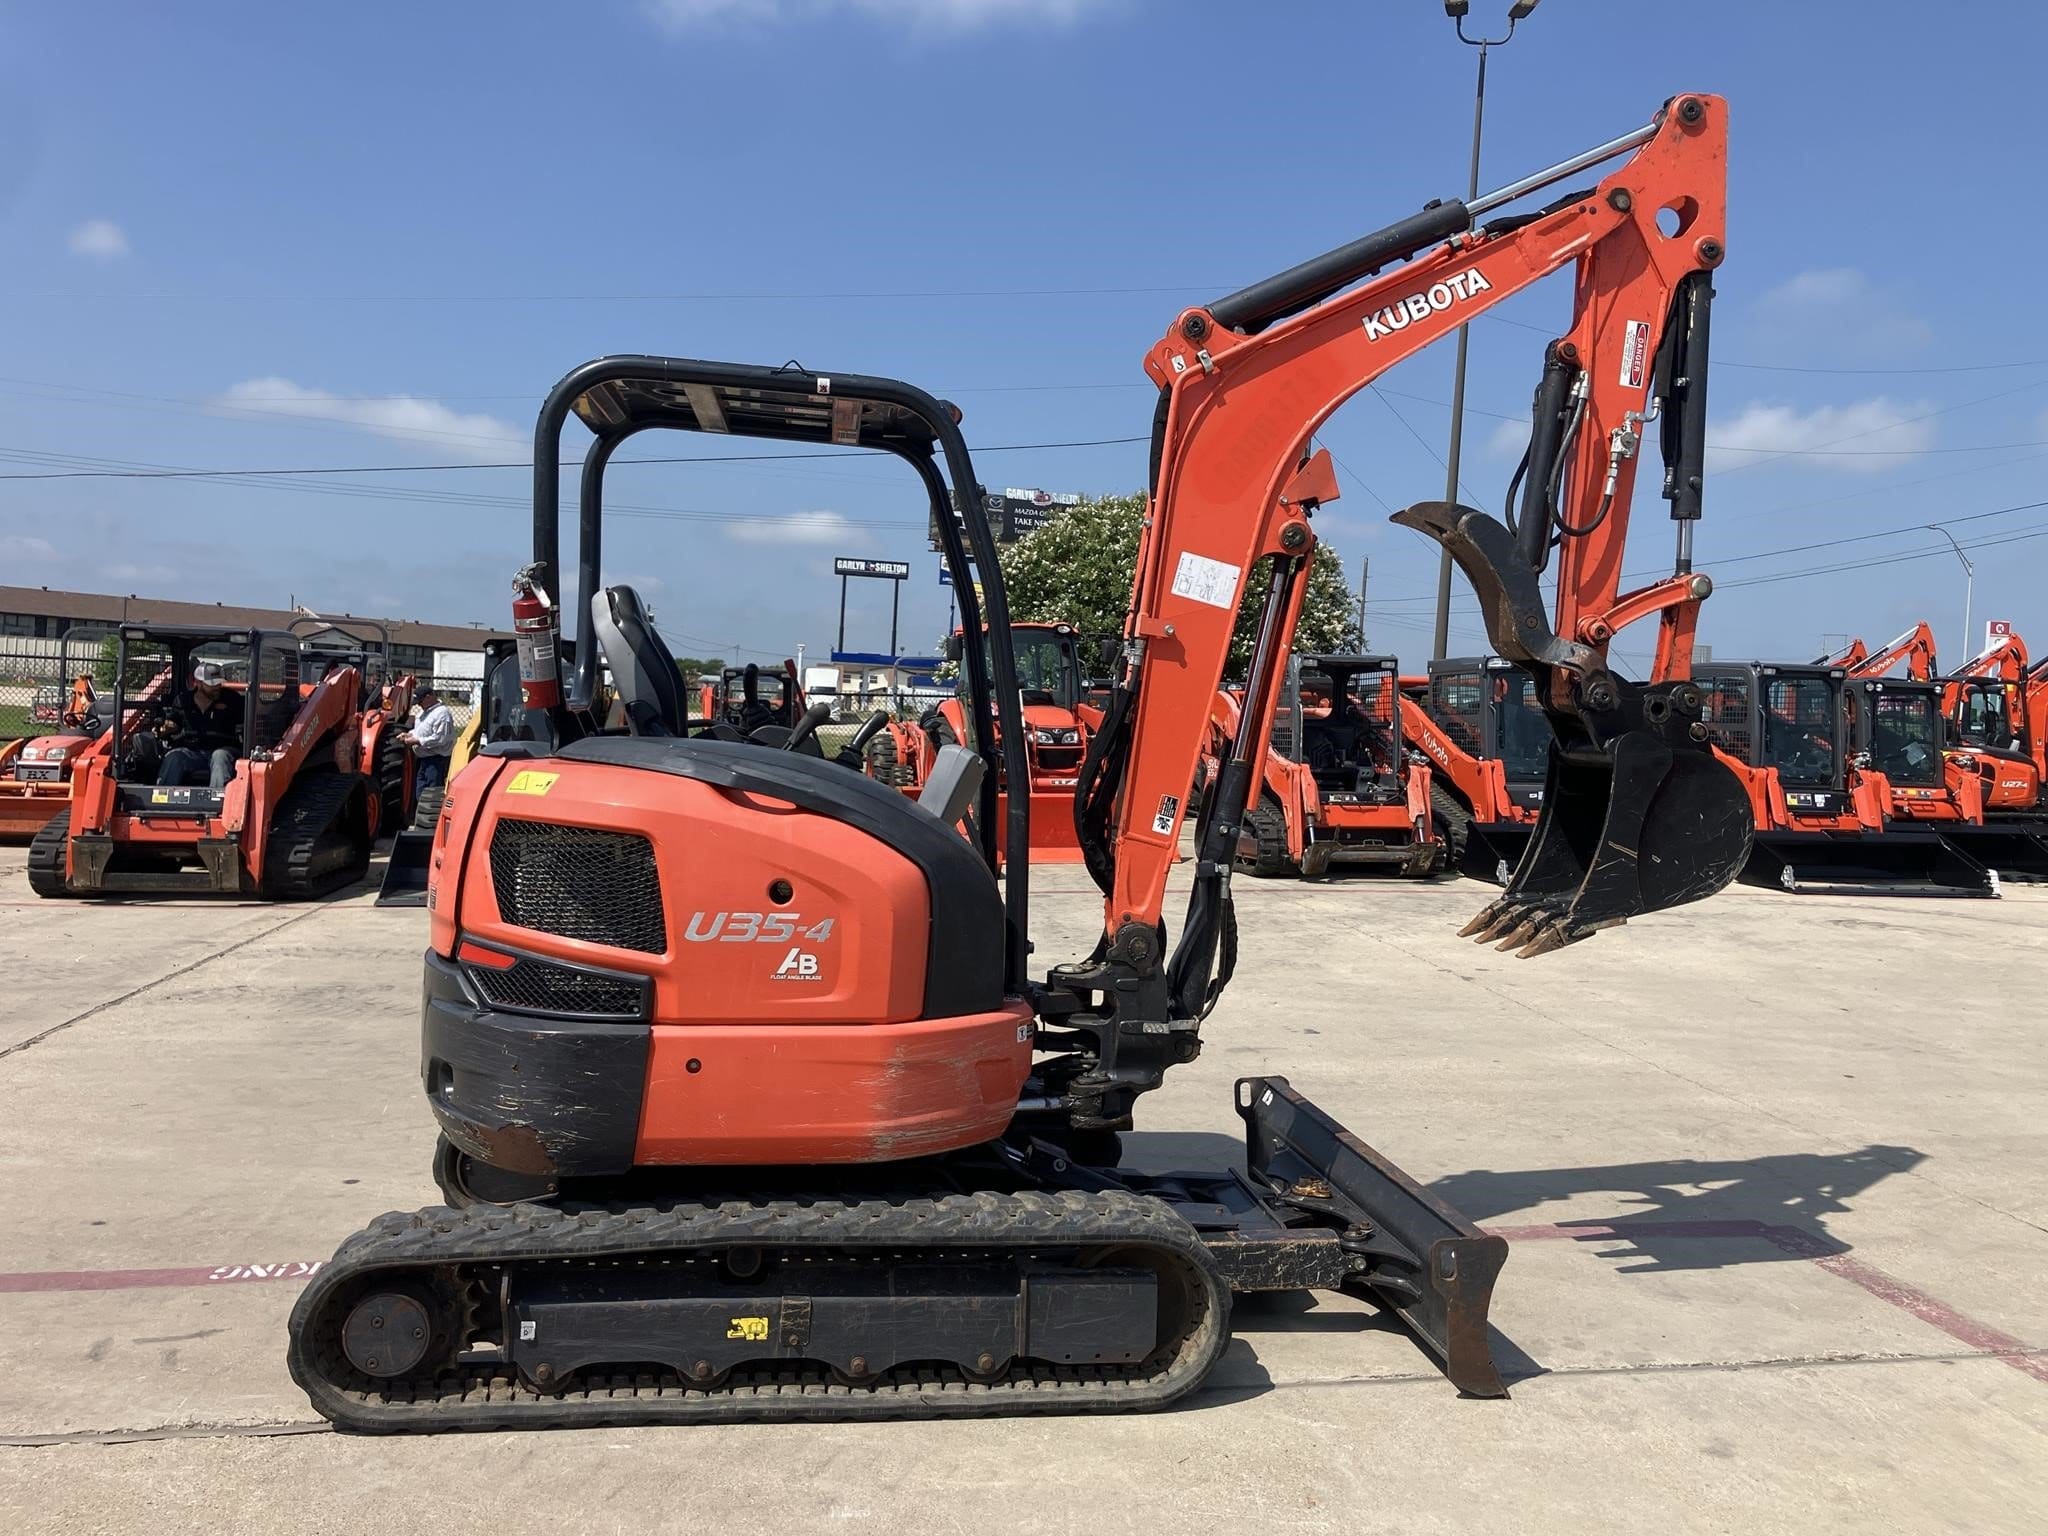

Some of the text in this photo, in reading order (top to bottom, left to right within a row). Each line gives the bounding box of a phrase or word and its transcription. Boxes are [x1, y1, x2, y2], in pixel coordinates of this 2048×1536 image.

[1361, 267, 1492, 342] KUBOTA
[1633, 337, 1644, 372] DANGER
[1014, 508, 1038, 516] MAZDA
[1014, 517, 1033, 526] TAKE
[837, 560, 907, 574] GARLYN SHELTON
[1423, 729, 1449, 766] Kubota
[2002, 780, 2028, 788] U27-4
[684, 912, 835, 943] U35-4
[776, 947, 819, 975] AB
